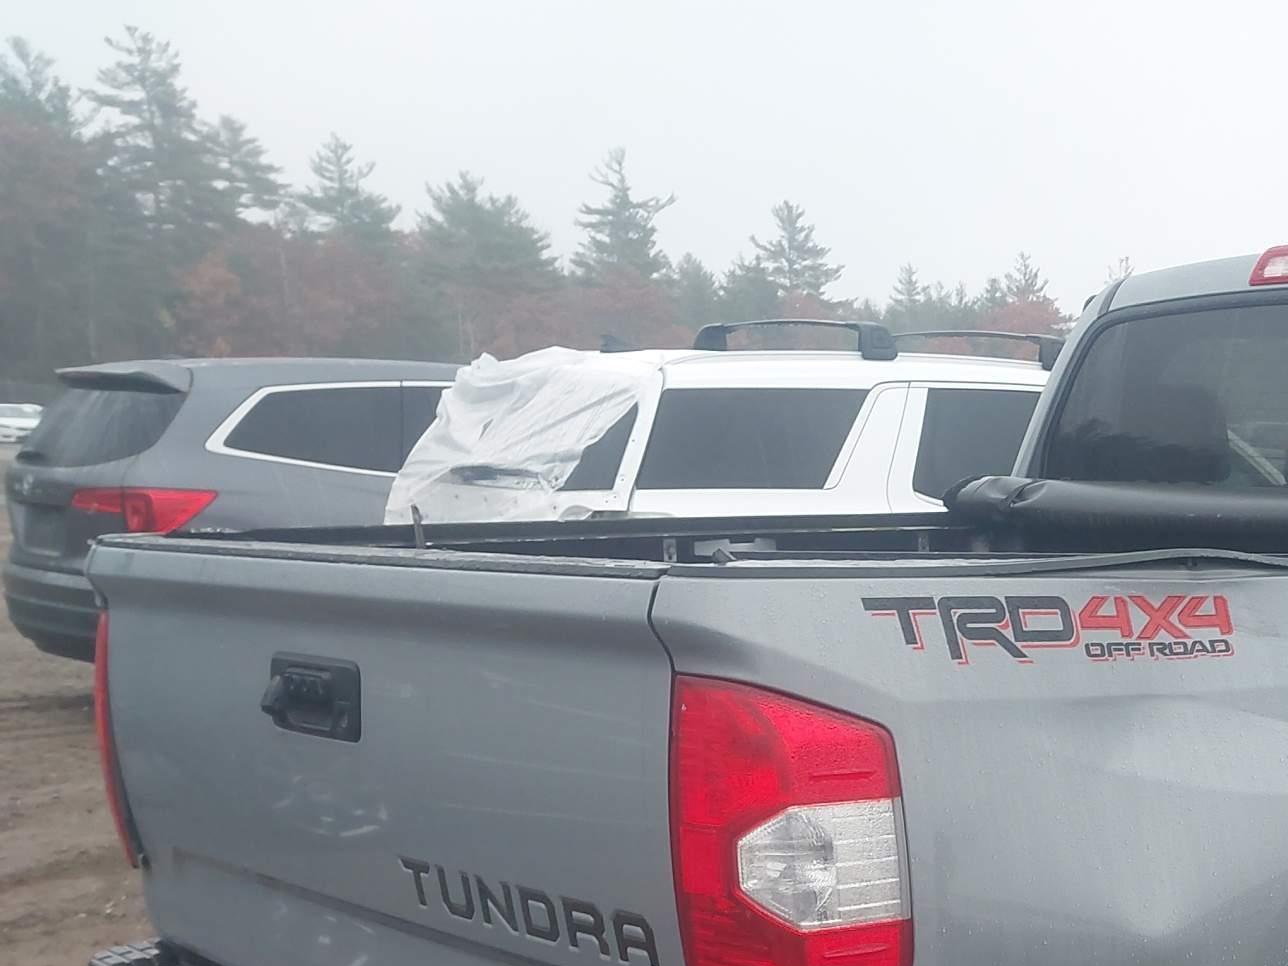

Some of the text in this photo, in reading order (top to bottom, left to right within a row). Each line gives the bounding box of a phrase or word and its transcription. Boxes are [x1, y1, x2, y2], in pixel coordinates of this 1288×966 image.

[861, 595, 1080, 664] TRD
[1084, 638, 1235, 661] OFF ROAD
